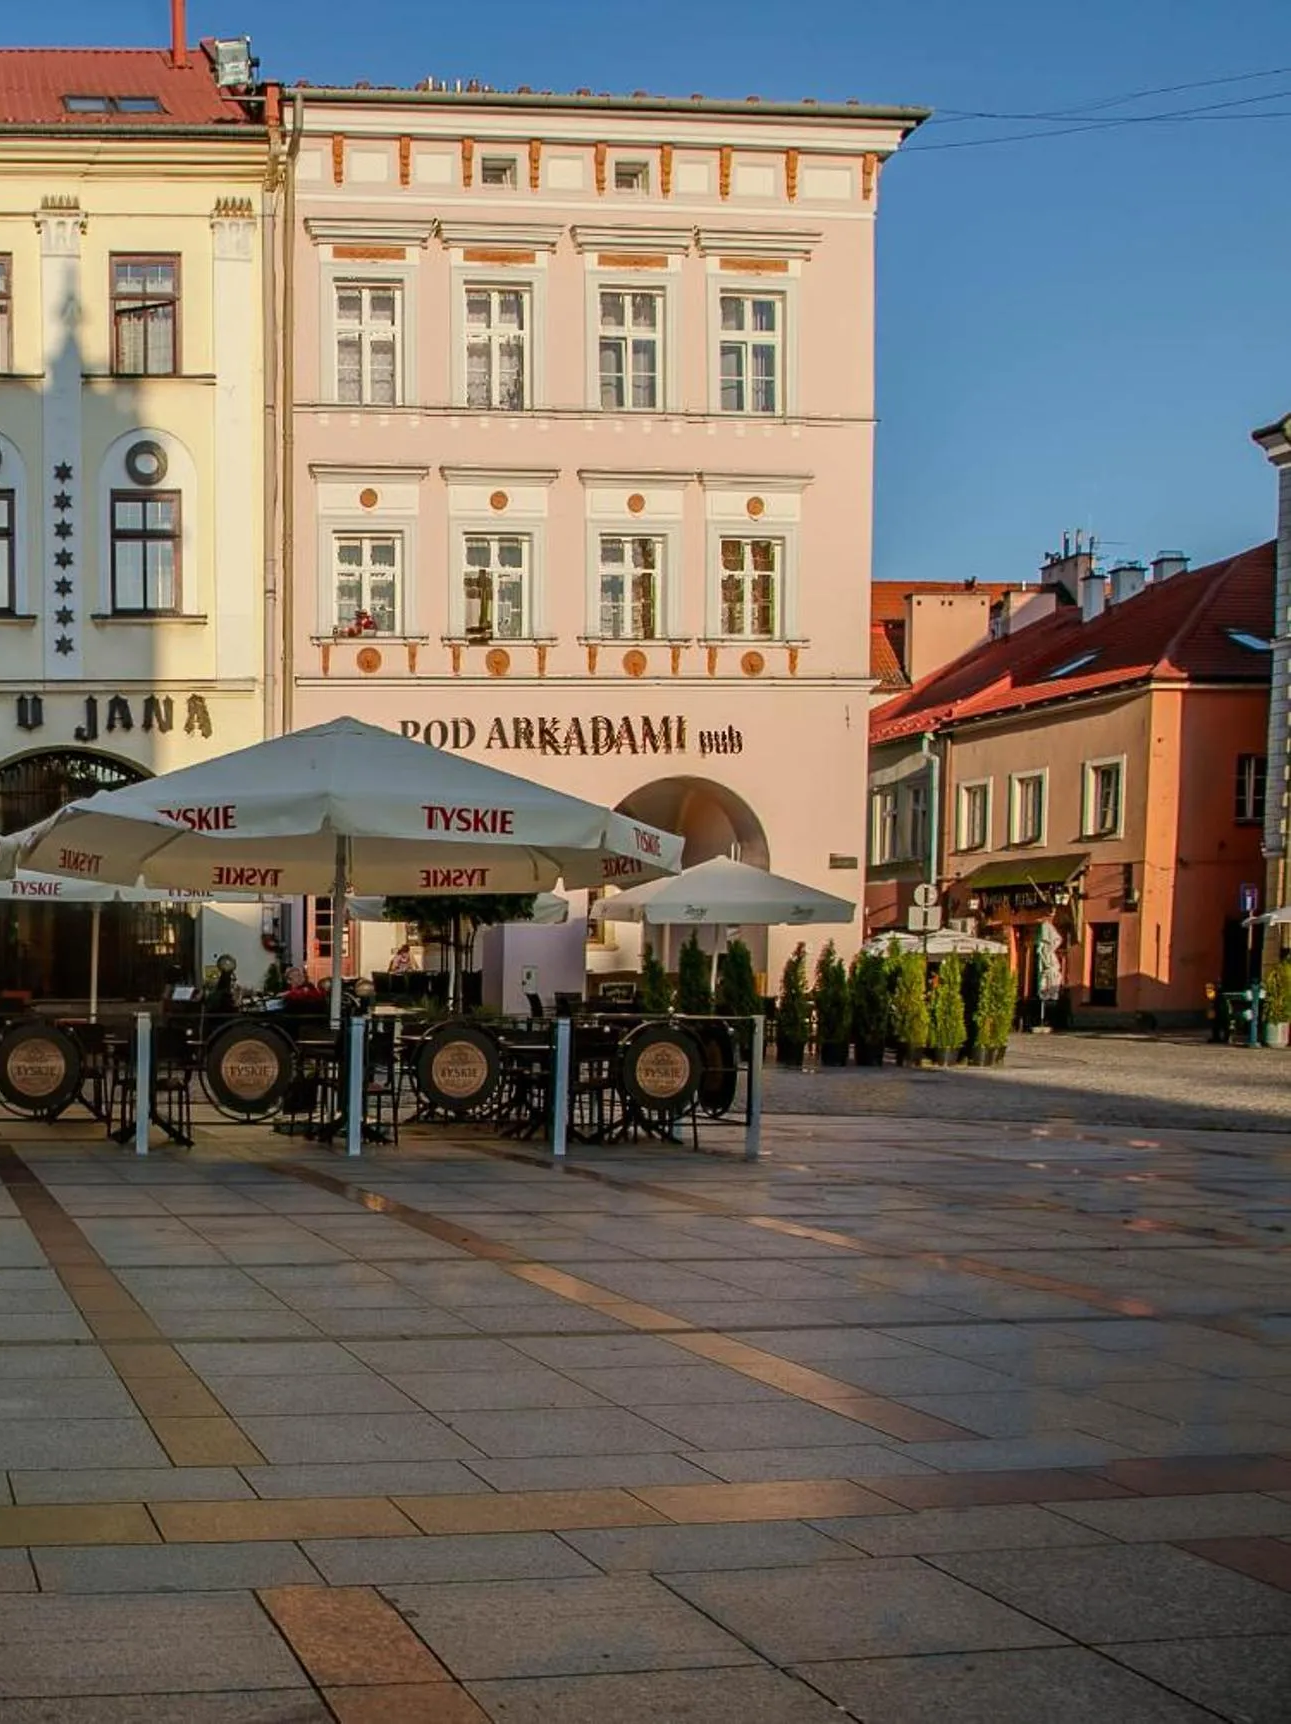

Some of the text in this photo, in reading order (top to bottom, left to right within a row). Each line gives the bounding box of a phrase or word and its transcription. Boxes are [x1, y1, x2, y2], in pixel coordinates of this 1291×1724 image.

[16, 693, 43, 731] U
[74, 693, 213, 743] JANA
[398, 715, 744, 757] POD ARKADAMI pub
[421, 806, 515, 835] TYSKIE
[12, 881, 64, 896] TYSKIE
